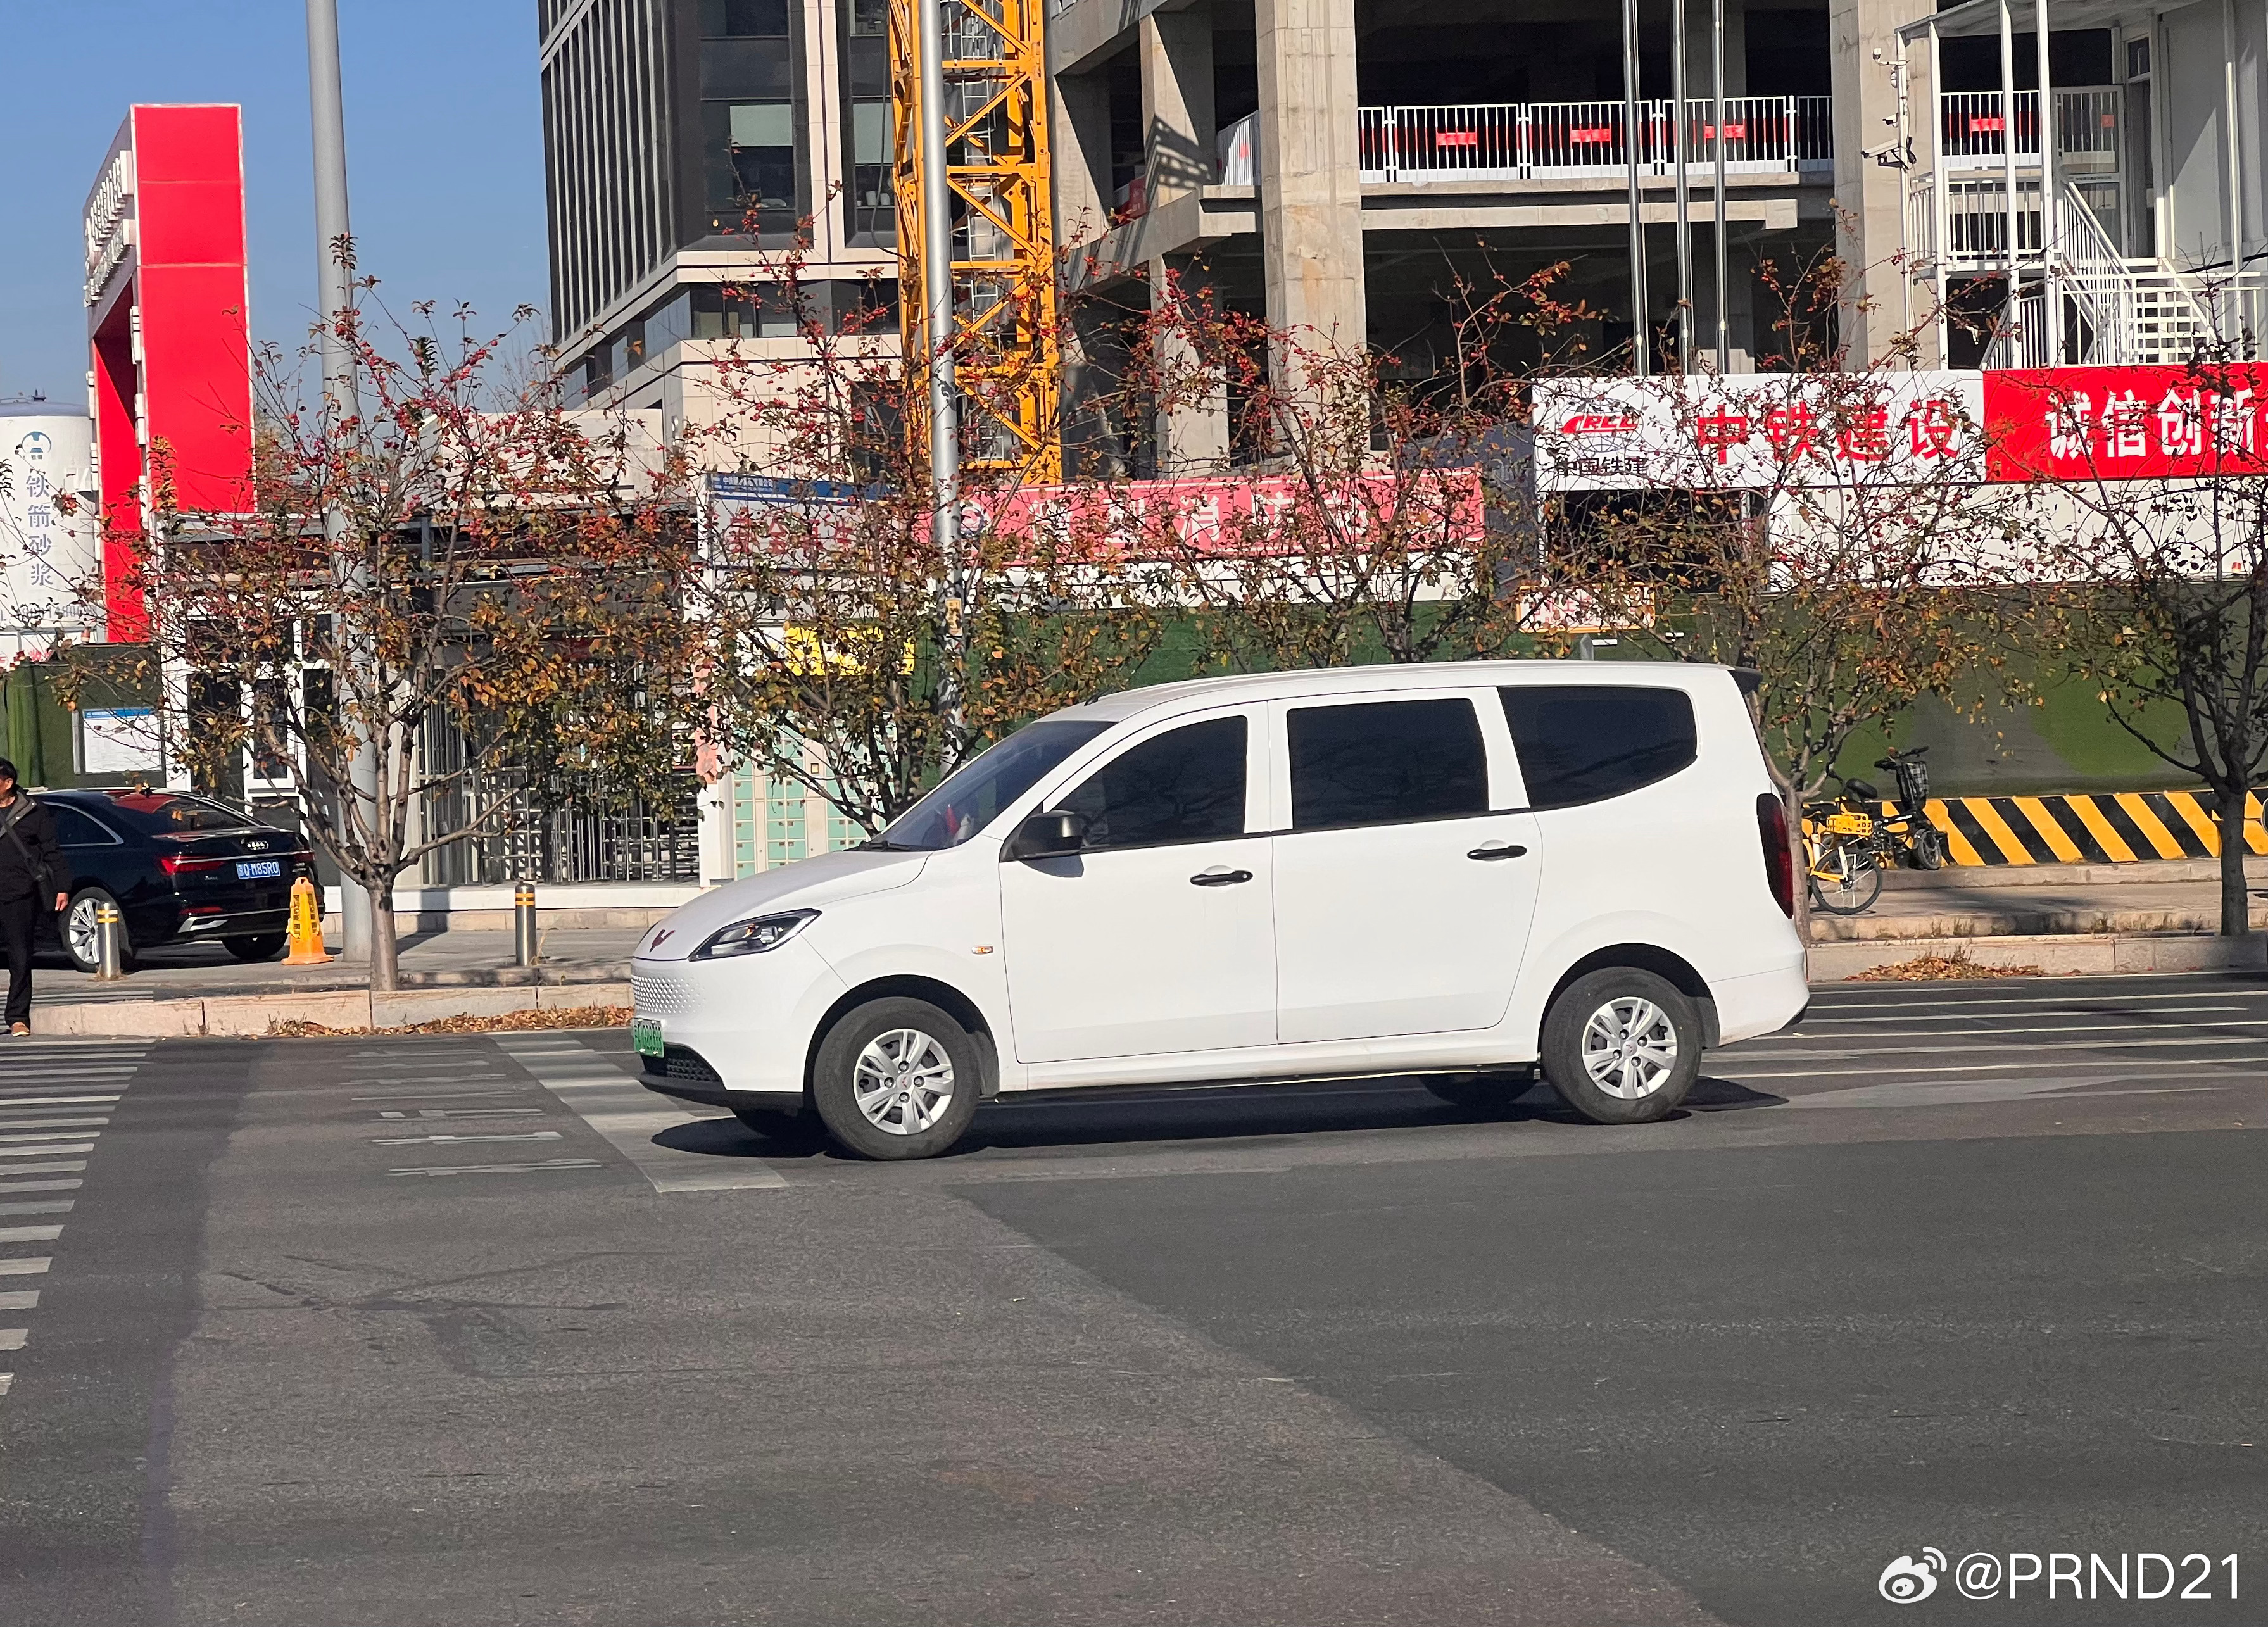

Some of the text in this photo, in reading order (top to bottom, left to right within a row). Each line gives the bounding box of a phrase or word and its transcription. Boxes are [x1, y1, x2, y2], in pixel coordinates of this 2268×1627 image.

[1696, 399, 1959, 465] 中铁建设
[2044, 387, 2268, 460] 诚信创新
[25, 475, 53, 586] 铁箭砂浆
